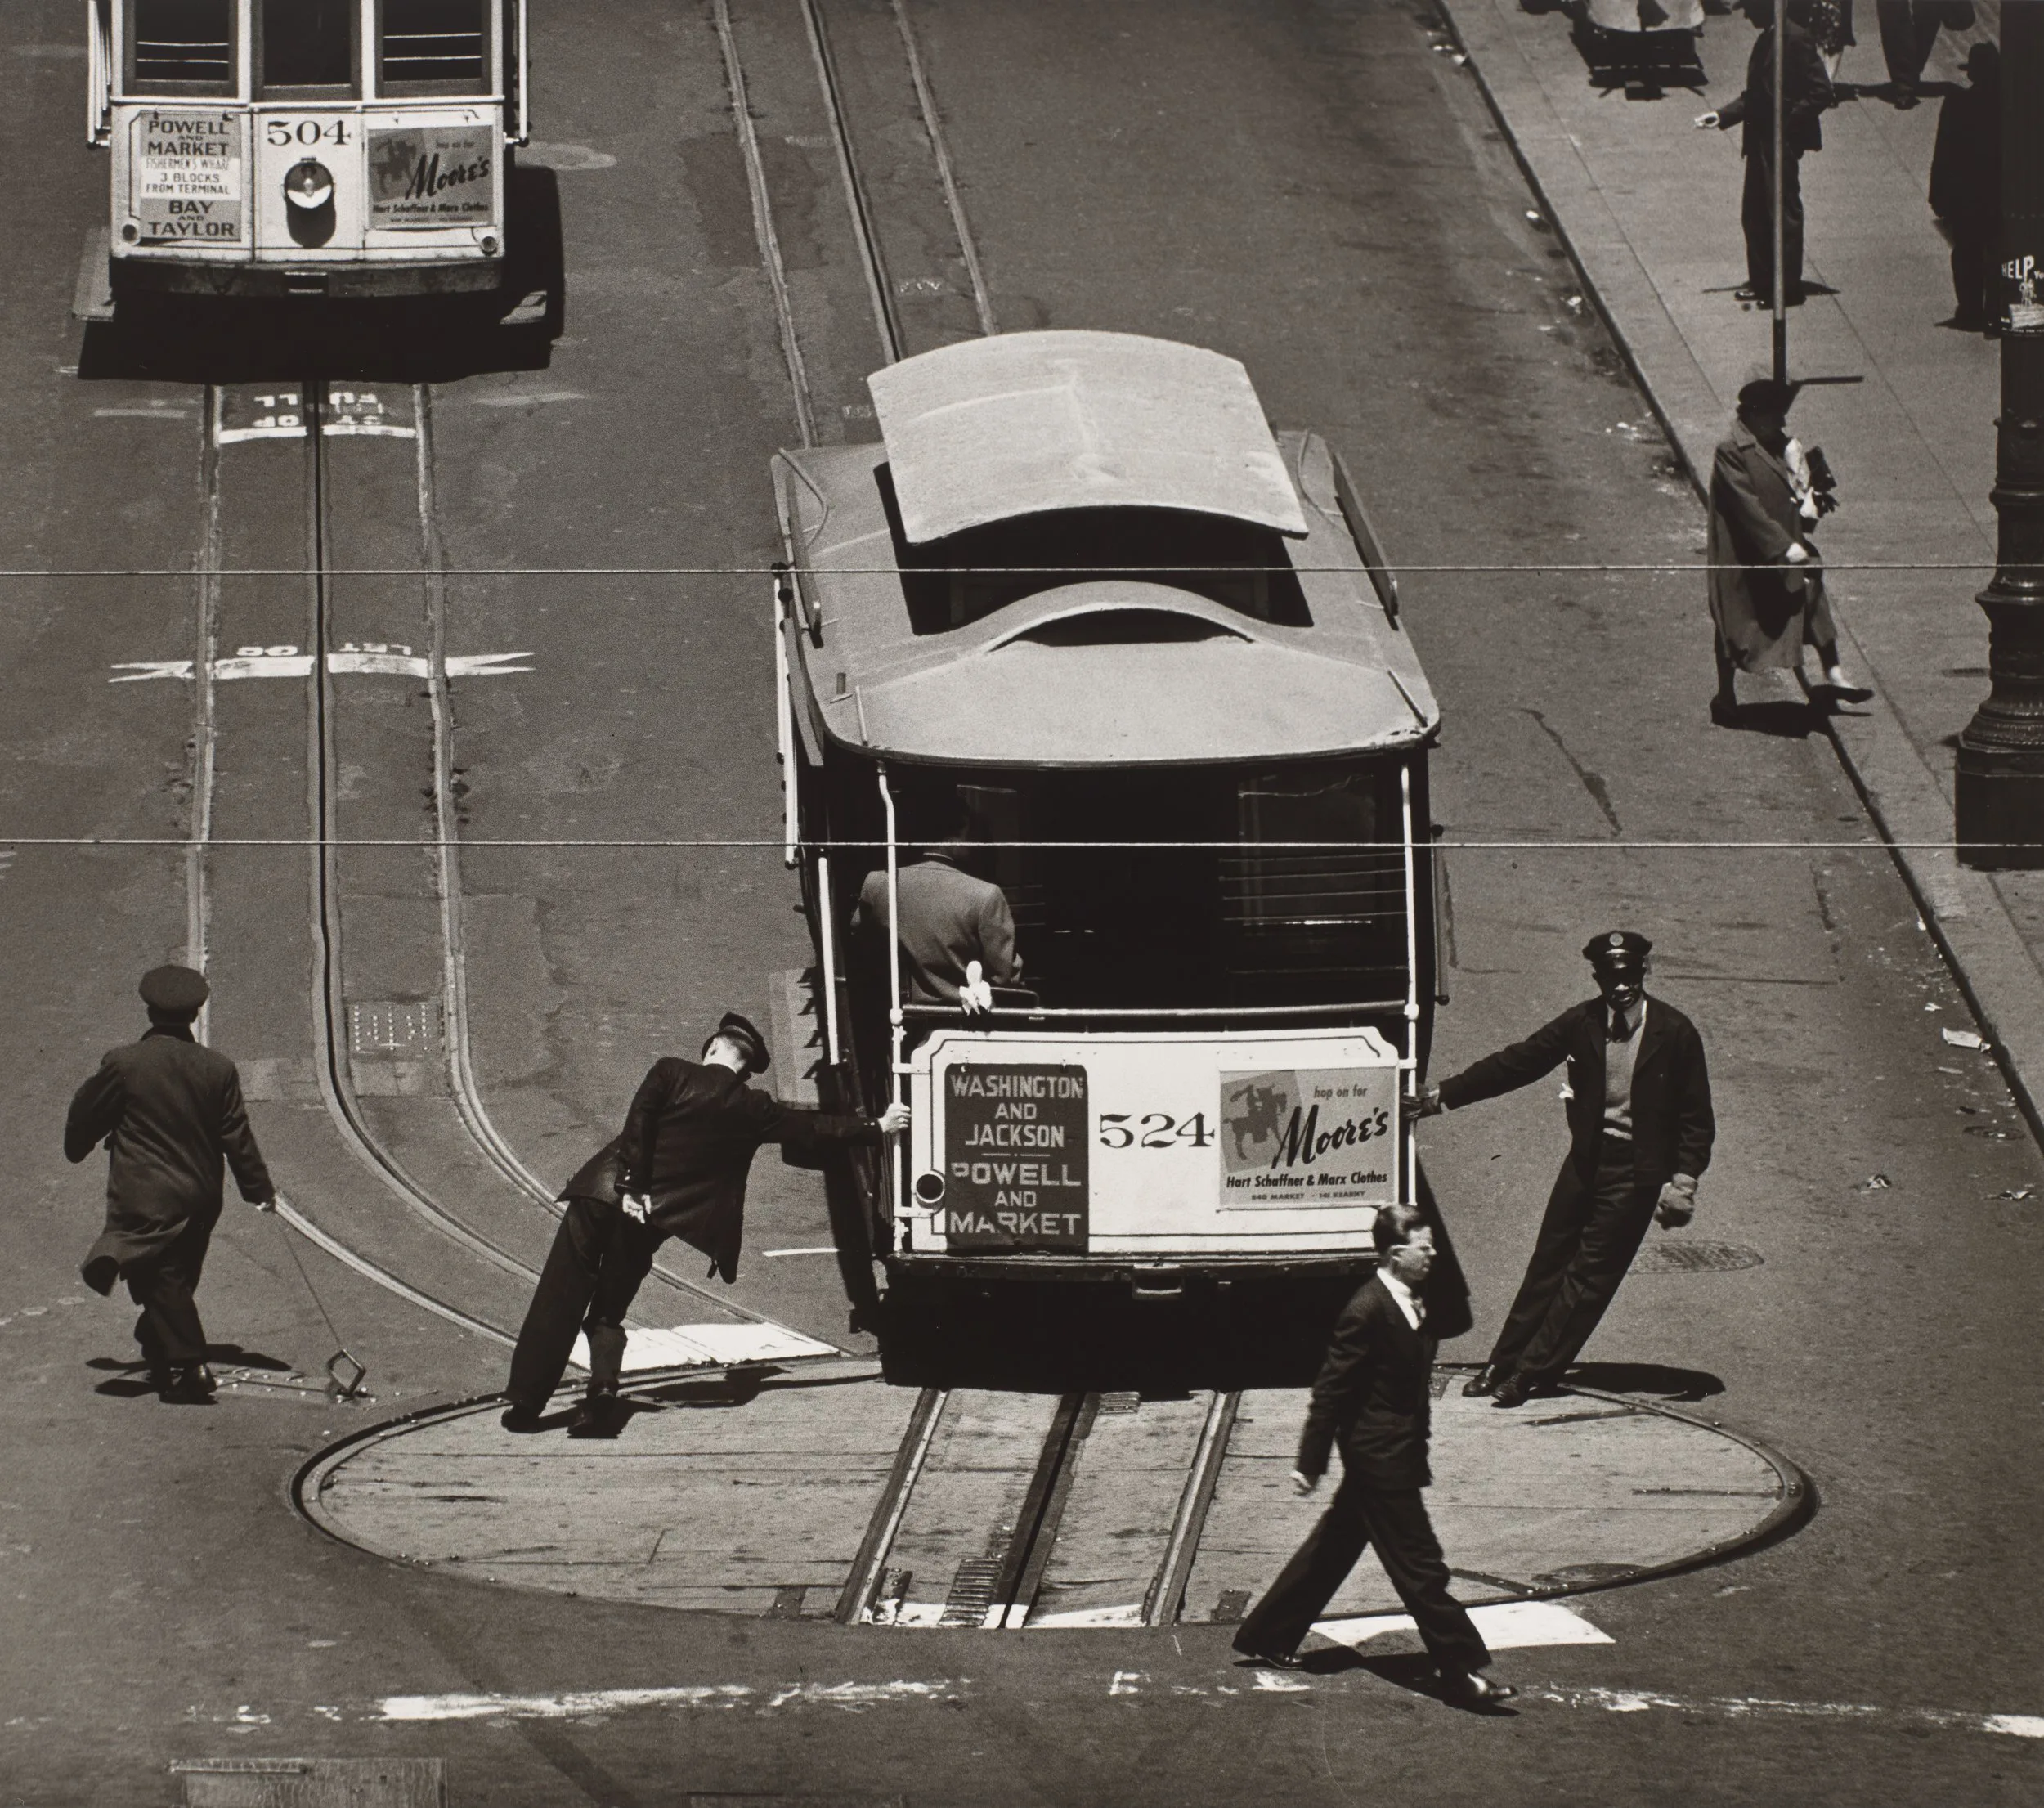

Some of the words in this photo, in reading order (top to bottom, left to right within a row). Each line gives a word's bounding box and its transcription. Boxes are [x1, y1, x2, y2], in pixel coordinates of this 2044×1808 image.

[149, 120, 230, 135] POWELL
[267, 120, 352, 146] 504
[148, 141, 229, 155] MARKET
[160, 173, 168, 182] 3
[173, 173, 220, 183] BLOCKS
[405, 153, 490, 200] Moore's
[146, 184, 173, 193] FROM
[178, 184, 231, 195] TERMINAL
[169, 200, 214, 214] BAY
[148, 222, 235, 236] TAYLOR
[2001, 255, 2034, 281] HELP
[950, 1074, 1083, 1099] WASHINGTON
[1314, 1086, 1333, 1100] hop
[1337, 1088, 1349, 1097] on
[1352, 1083, 1368, 1097] for
[994, 1103, 1037, 1119] AND
[965, 1124, 1065, 1148] JACKSON
[1100, 1112, 1215, 1149] 524
[1271, 1104, 1389, 1169] Moore's
[950, 1163, 1081, 1186] POWELL
[1226, 1176, 1251, 1188] Hart
[1254, 1173, 1304, 1188] Schaffner
[1306, 1174, 1315, 1186] &
[1318, 1173, 1347, 1185] Marx
[1351, 1170, 1387, 1185] Clothes
[994, 1191, 1037, 1207] AND
[950, 1211, 1081, 1235] MARKET
